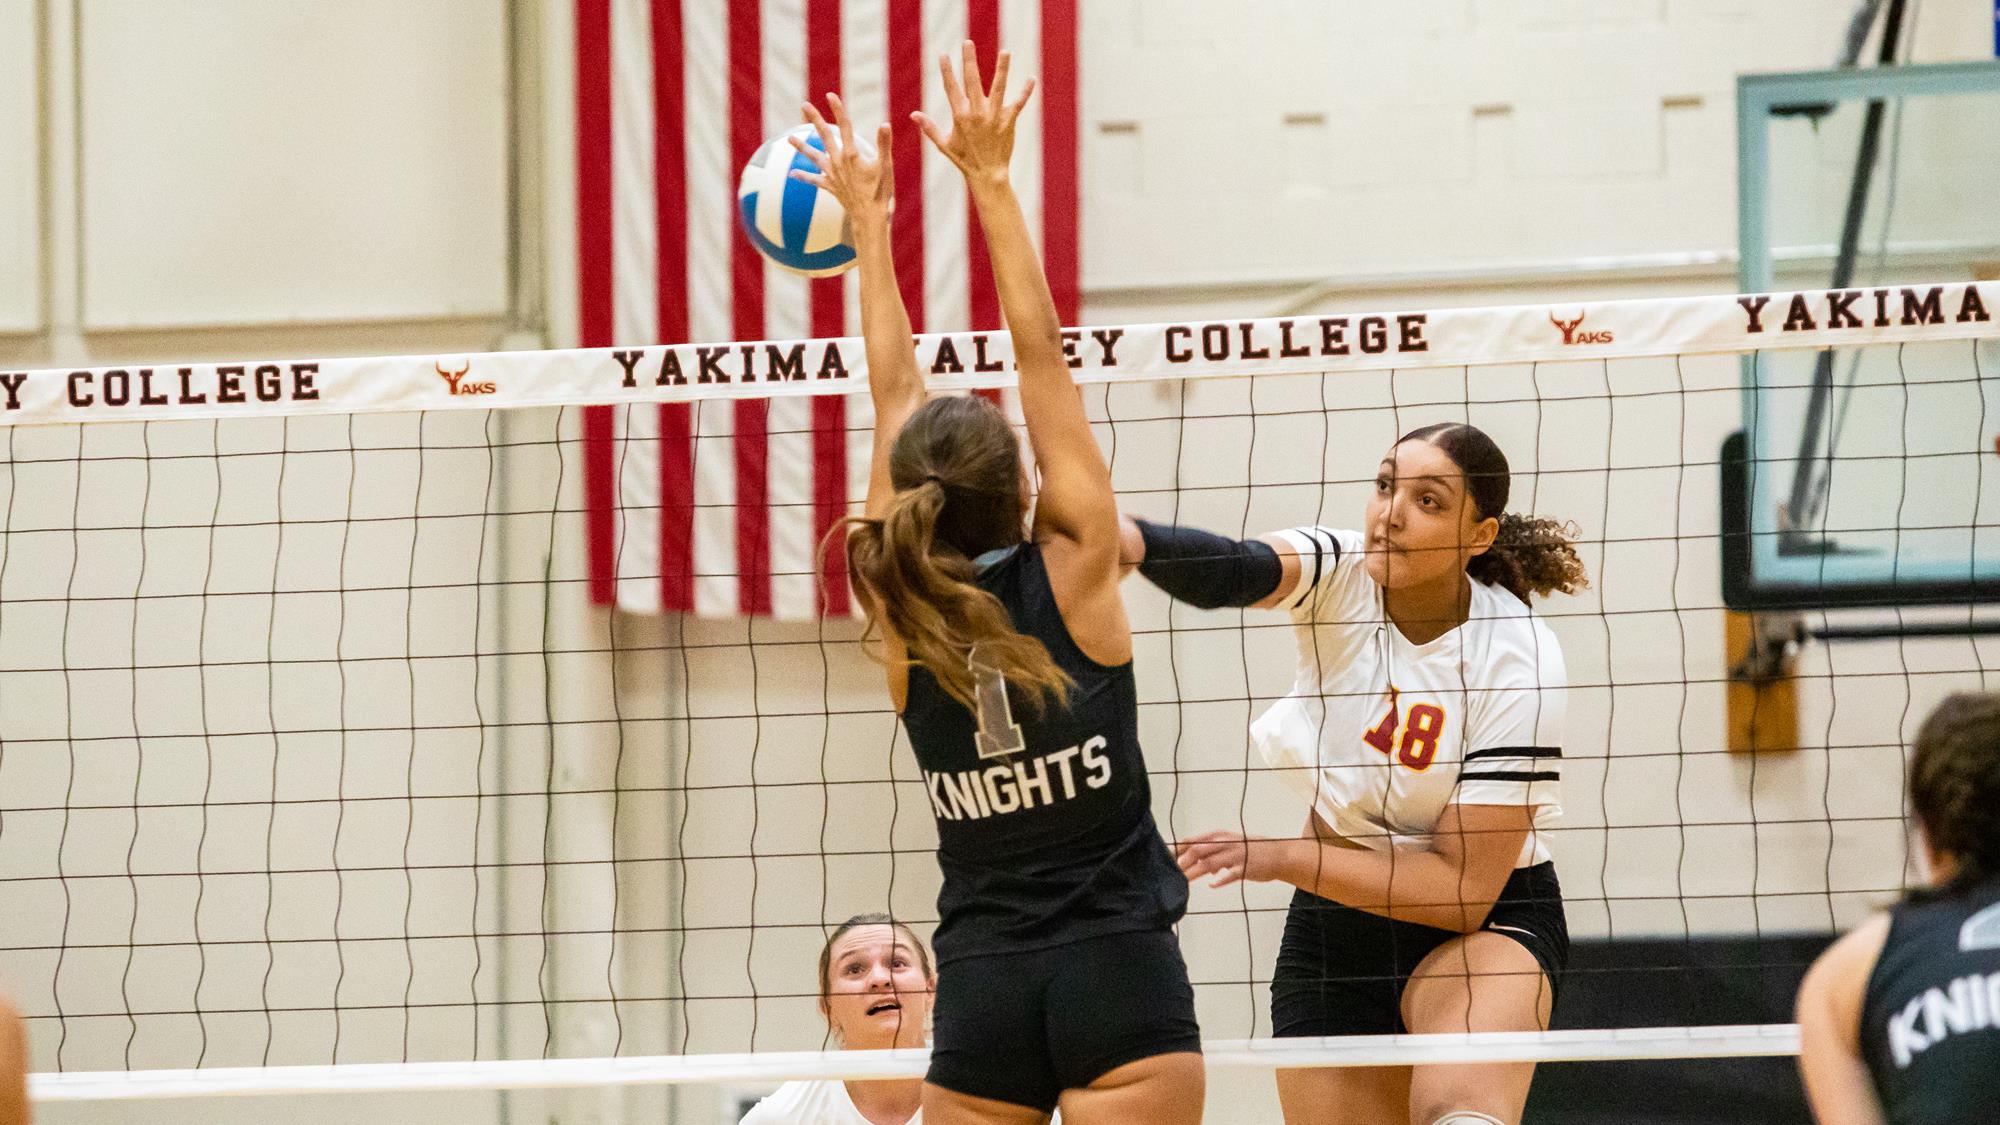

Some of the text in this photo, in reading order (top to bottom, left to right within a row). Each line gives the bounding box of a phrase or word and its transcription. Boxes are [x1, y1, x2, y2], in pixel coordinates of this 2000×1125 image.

[1737, 285, 1991, 333] YAKIMA
[67, 363, 320, 408] COLLEGE
[612, 313, 1428, 388] YAKIMA ALEY COLLEGE
[968, 642, 1025, 759] 1
[1363, 683, 1445, 773] 18
[924, 735, 1112, 821] KNIGHTS
